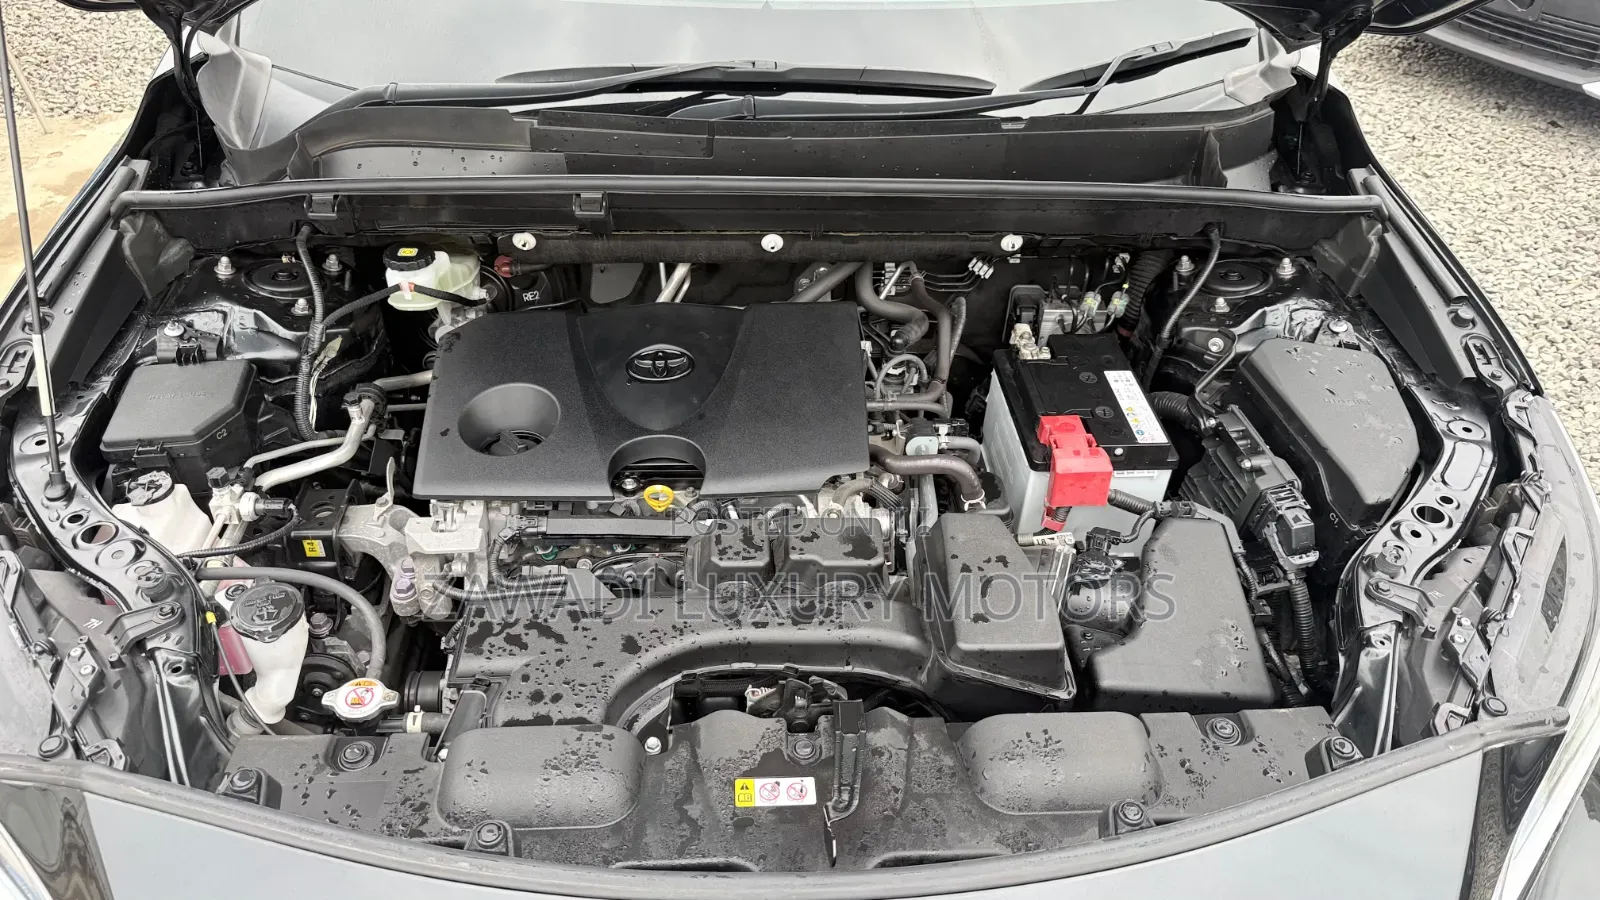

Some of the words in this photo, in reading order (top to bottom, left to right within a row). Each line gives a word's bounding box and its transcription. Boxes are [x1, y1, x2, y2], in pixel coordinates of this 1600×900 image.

[522, 290, 540, 302] RE2
[216, 428, 228, 440] C2
[306, 541, 317, 553] R4
